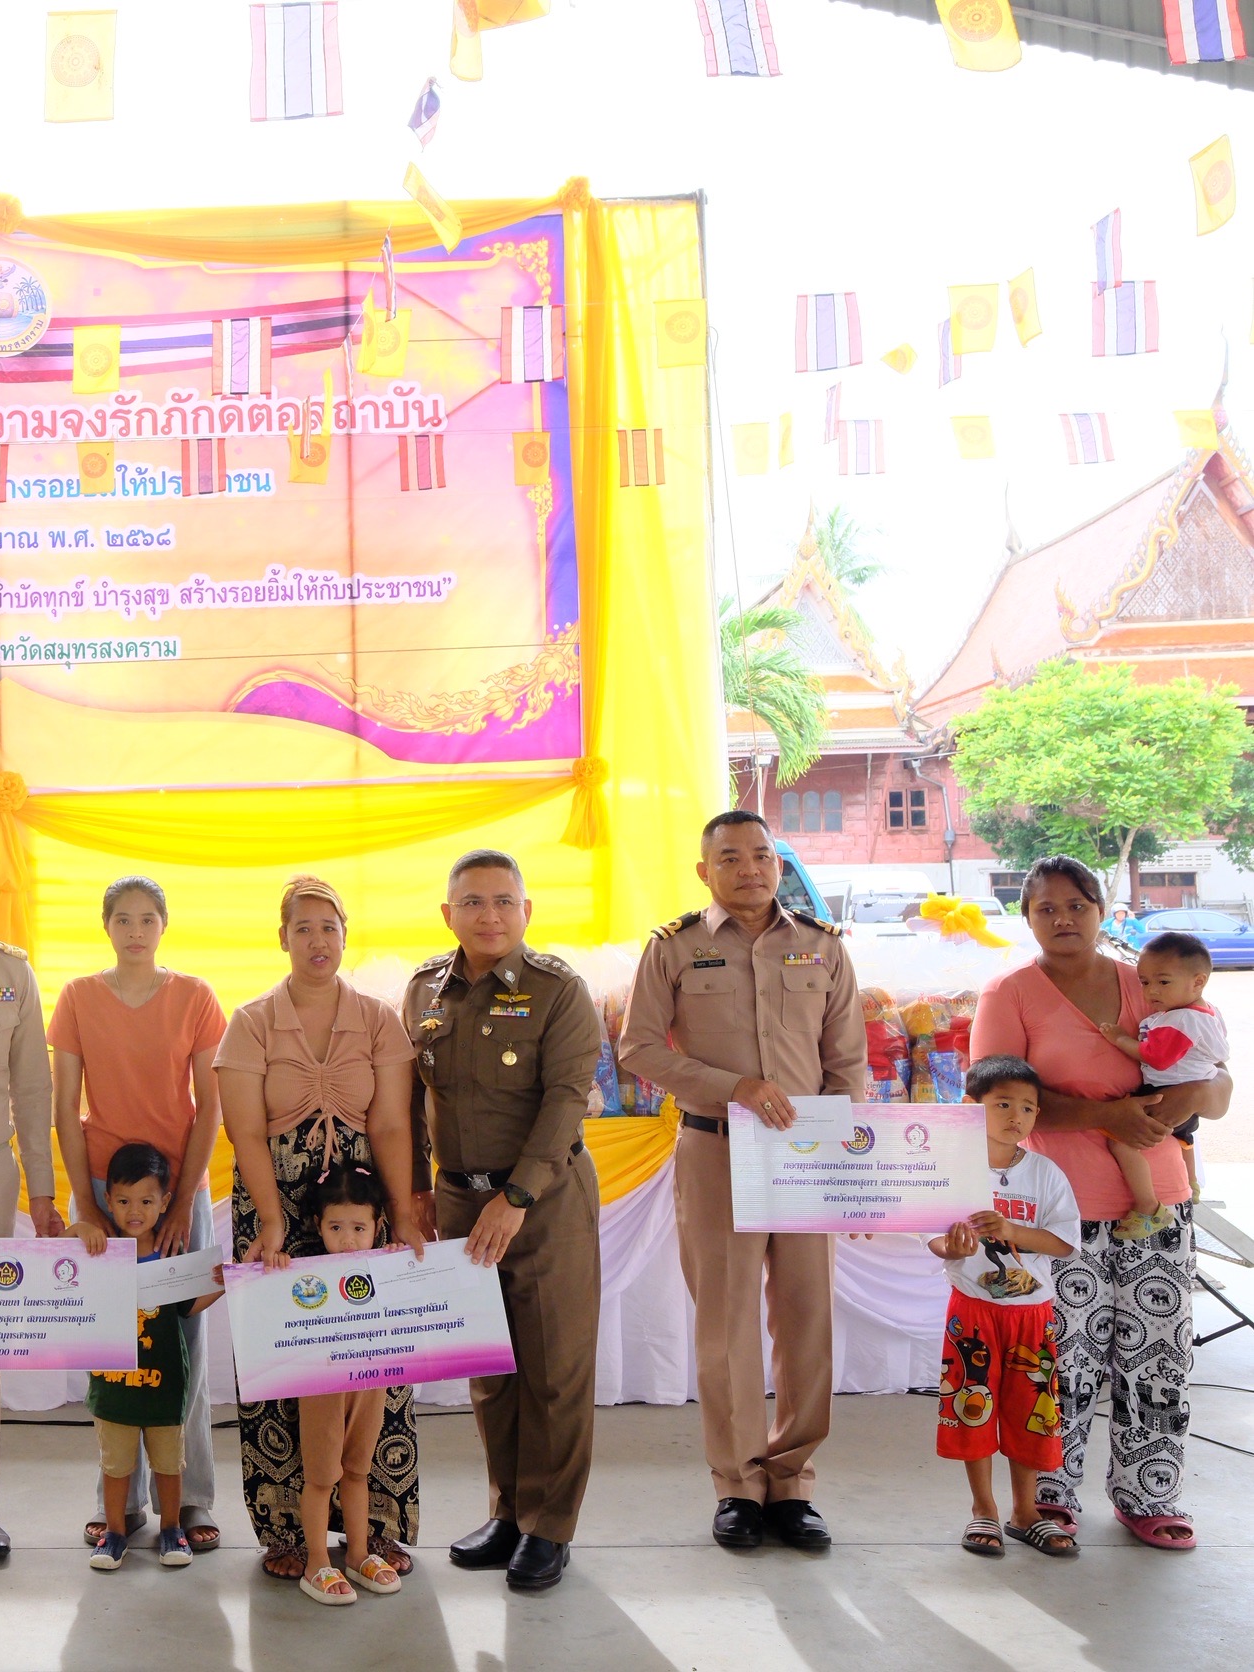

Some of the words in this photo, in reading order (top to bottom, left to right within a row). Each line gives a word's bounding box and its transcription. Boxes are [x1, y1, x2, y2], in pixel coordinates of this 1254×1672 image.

[48, 528, 95, 550] พ.ศ.
[105, 527, 172, 549] ๒๕๖๘
[93, 583, 170, 617] บำรุงสุข
[179, 569, 453, 607] สร้างรอยยิ้มให้กับประชาชน”
[993, 1198, 1037, 1223] REX
[91, 1368, 162, 1387] RFIELD
[348, 1369, 379, 1382] 1,000
